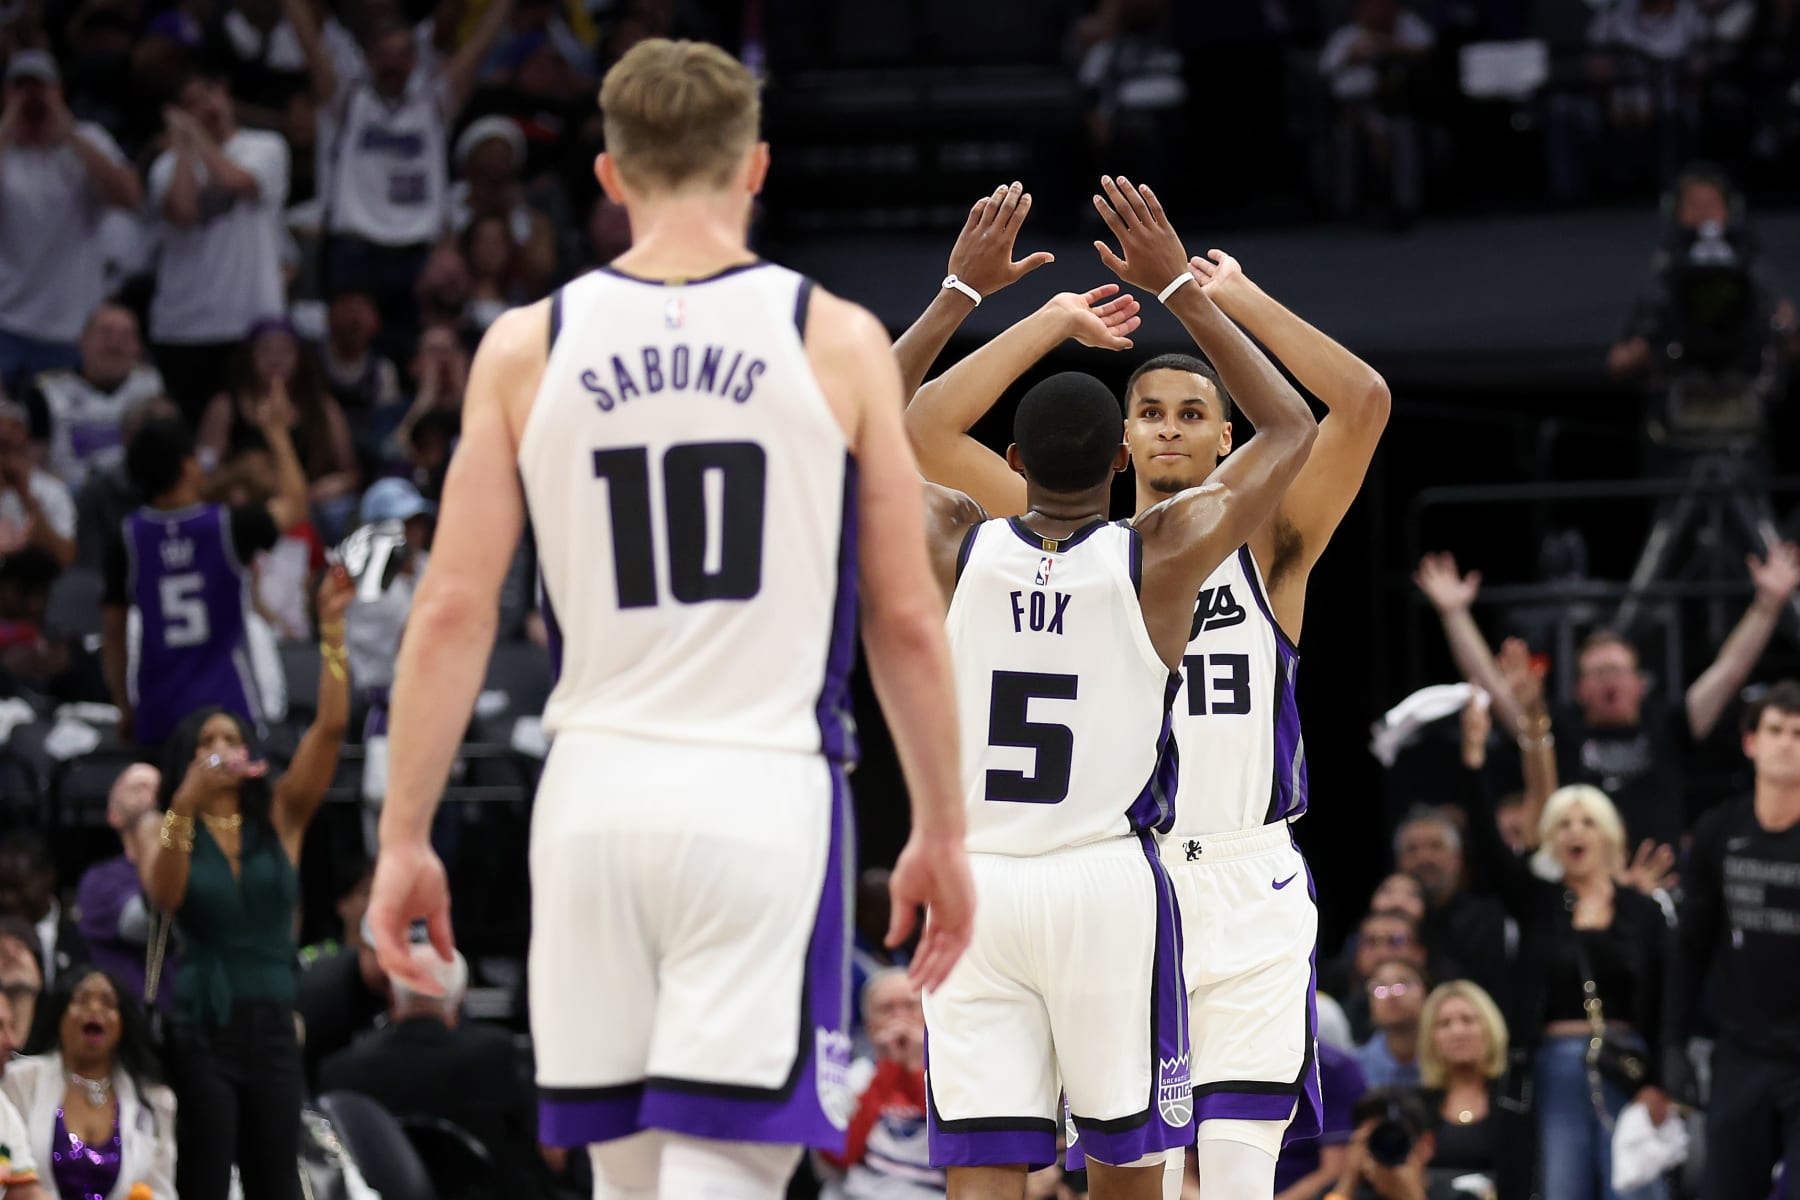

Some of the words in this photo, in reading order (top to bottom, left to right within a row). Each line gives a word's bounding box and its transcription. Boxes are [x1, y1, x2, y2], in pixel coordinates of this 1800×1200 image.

[581, 344, 767, 413] SABONIS
[593, 441, 767, 610] 10
[160, 573, 210, 646] 5
[1010, 590, 1072, 635] FOX
[1182, 653, 1251, 716] 13
[985, 670, 1078, 805] 5
[1160, 1082, 1192, 1101] KINGS
